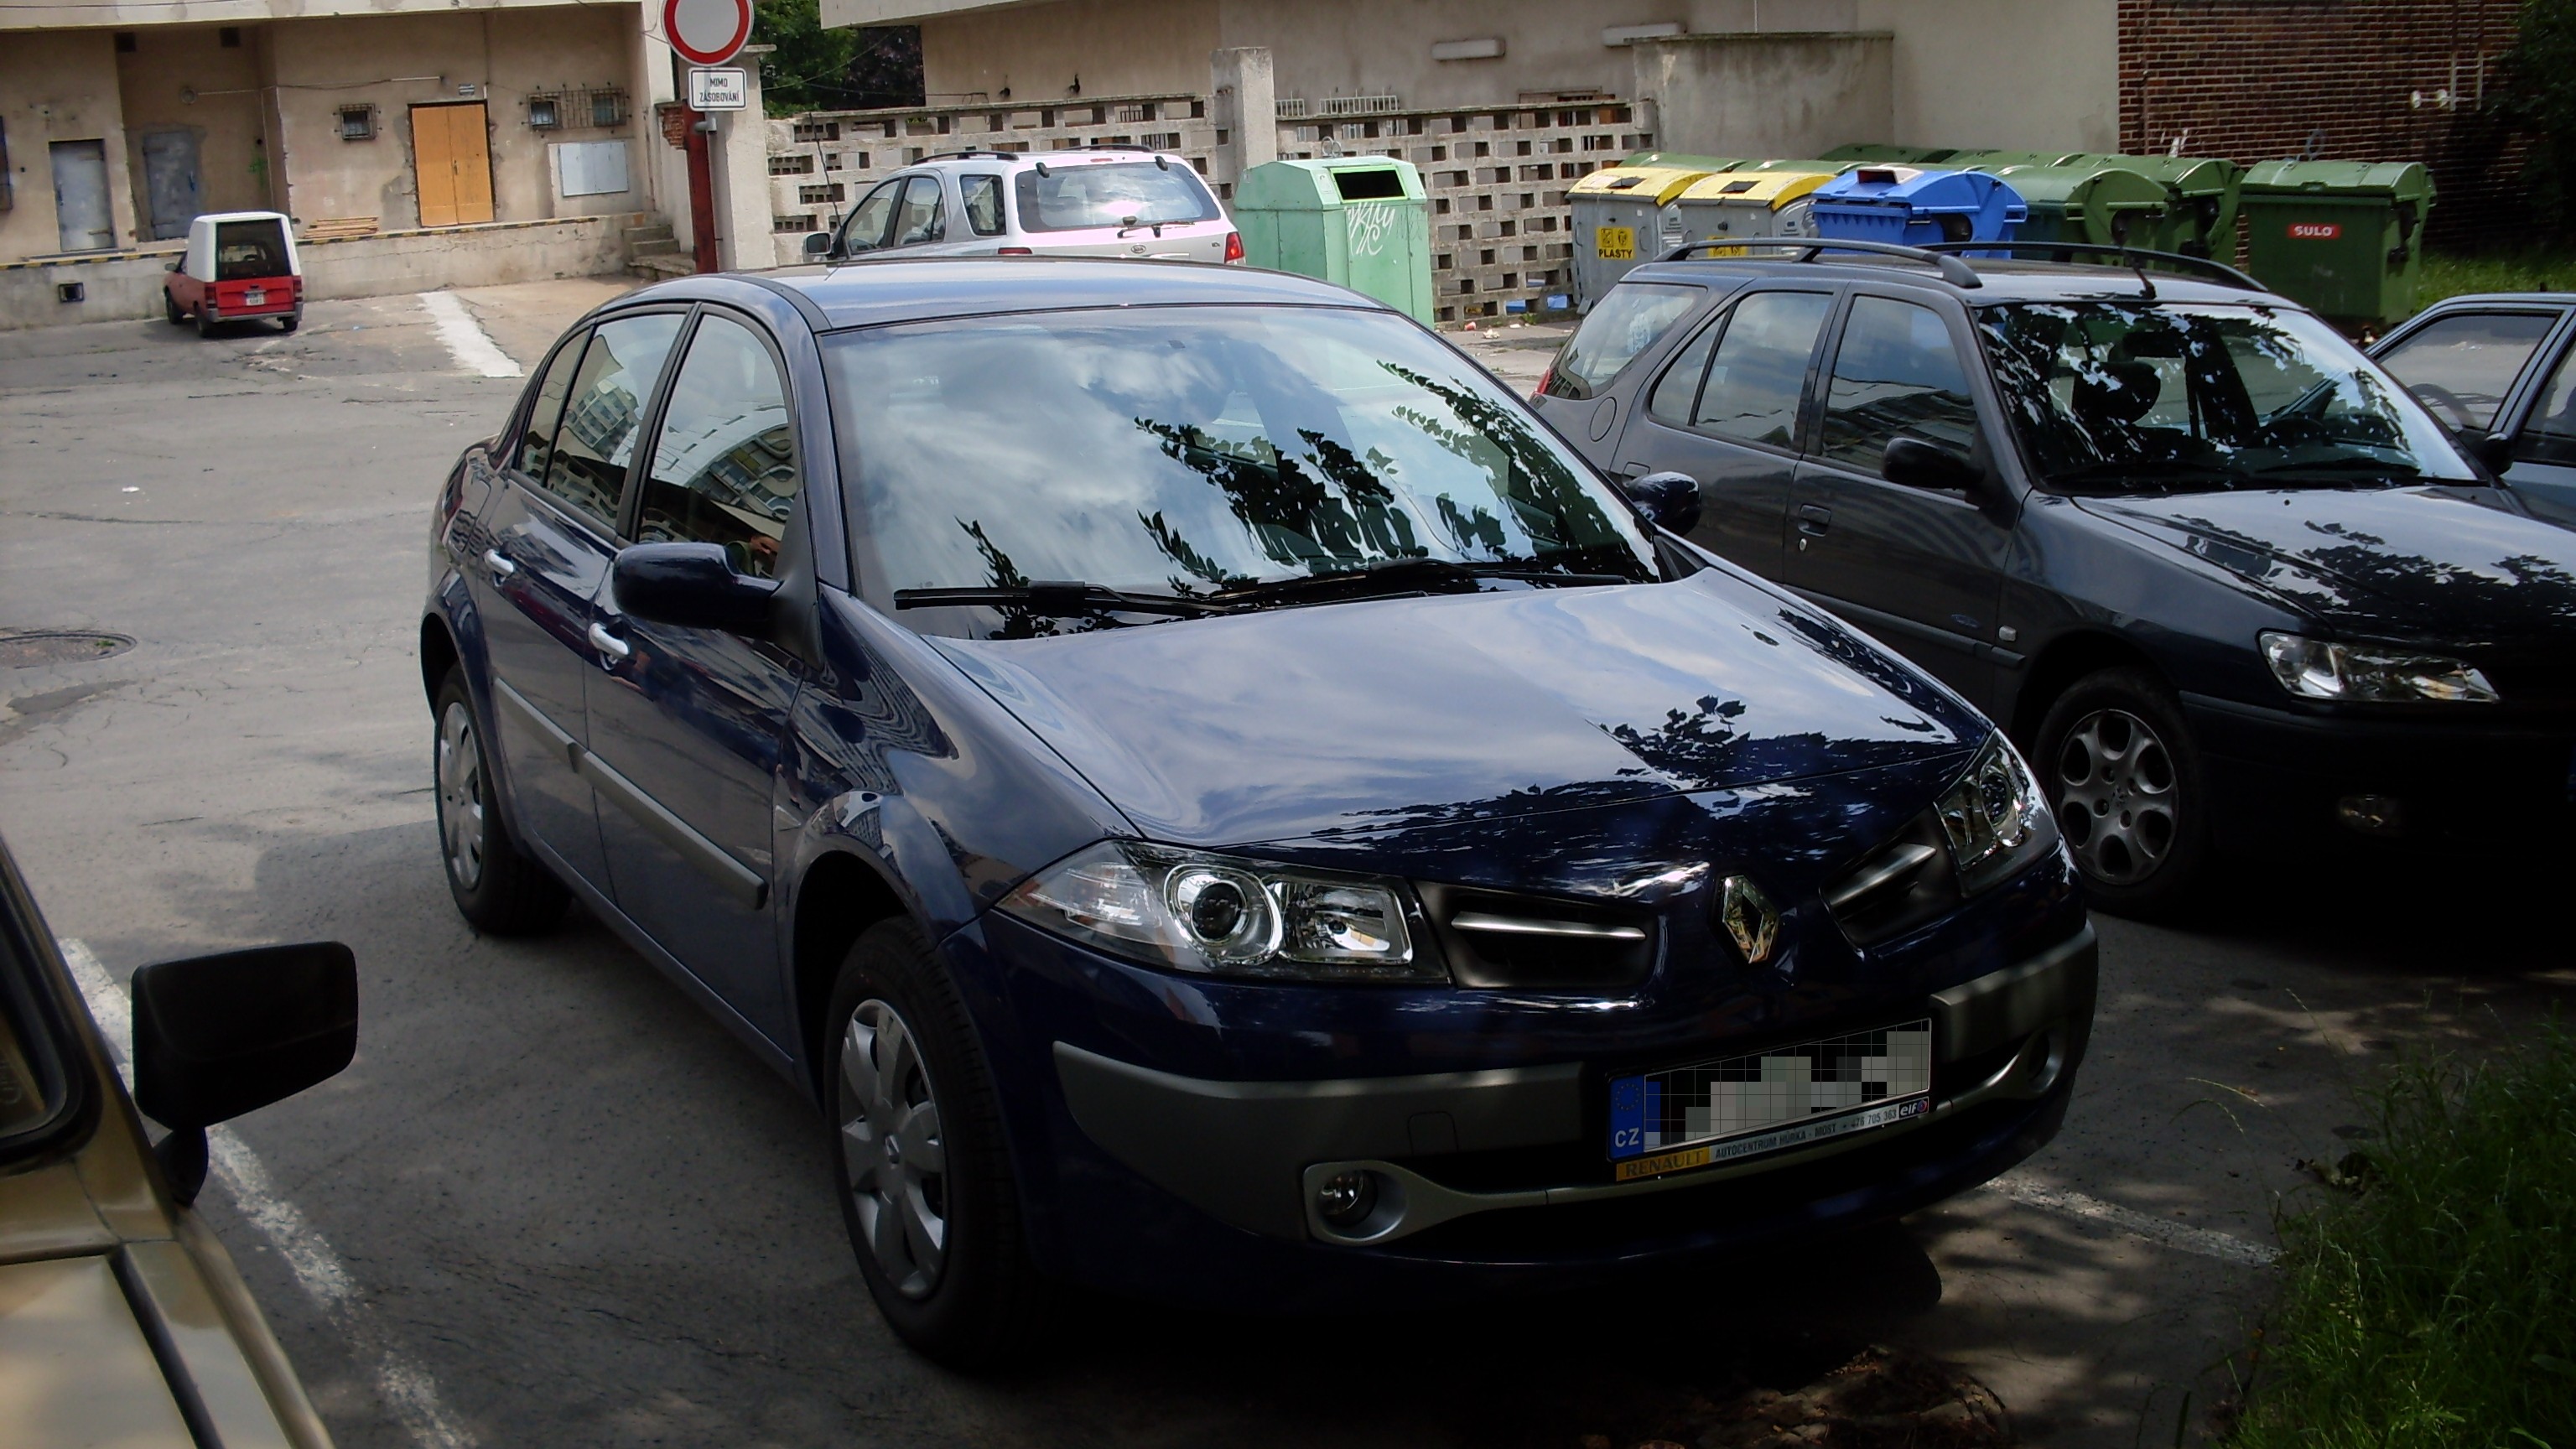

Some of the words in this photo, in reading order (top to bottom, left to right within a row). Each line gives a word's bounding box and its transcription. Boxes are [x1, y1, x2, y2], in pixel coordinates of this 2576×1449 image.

[709, 78, 728, 87] MIMO
[699, 90, 740, 102] ZÁSOBOVÁNÍ
[2293, 226, 2333, 236] SULO
[1598, 248, 1633, 259] PLASTY
[1899, 1102, 1919, 1117] elf
[1614, 1127, 1640, 1149] CZ
[1715, 1136, 1777, 1159] AUTOCENTRUM
[1867, 1113, 1881, 1124] 705
[1625, 1150, 1705, 1176] RENAULT
